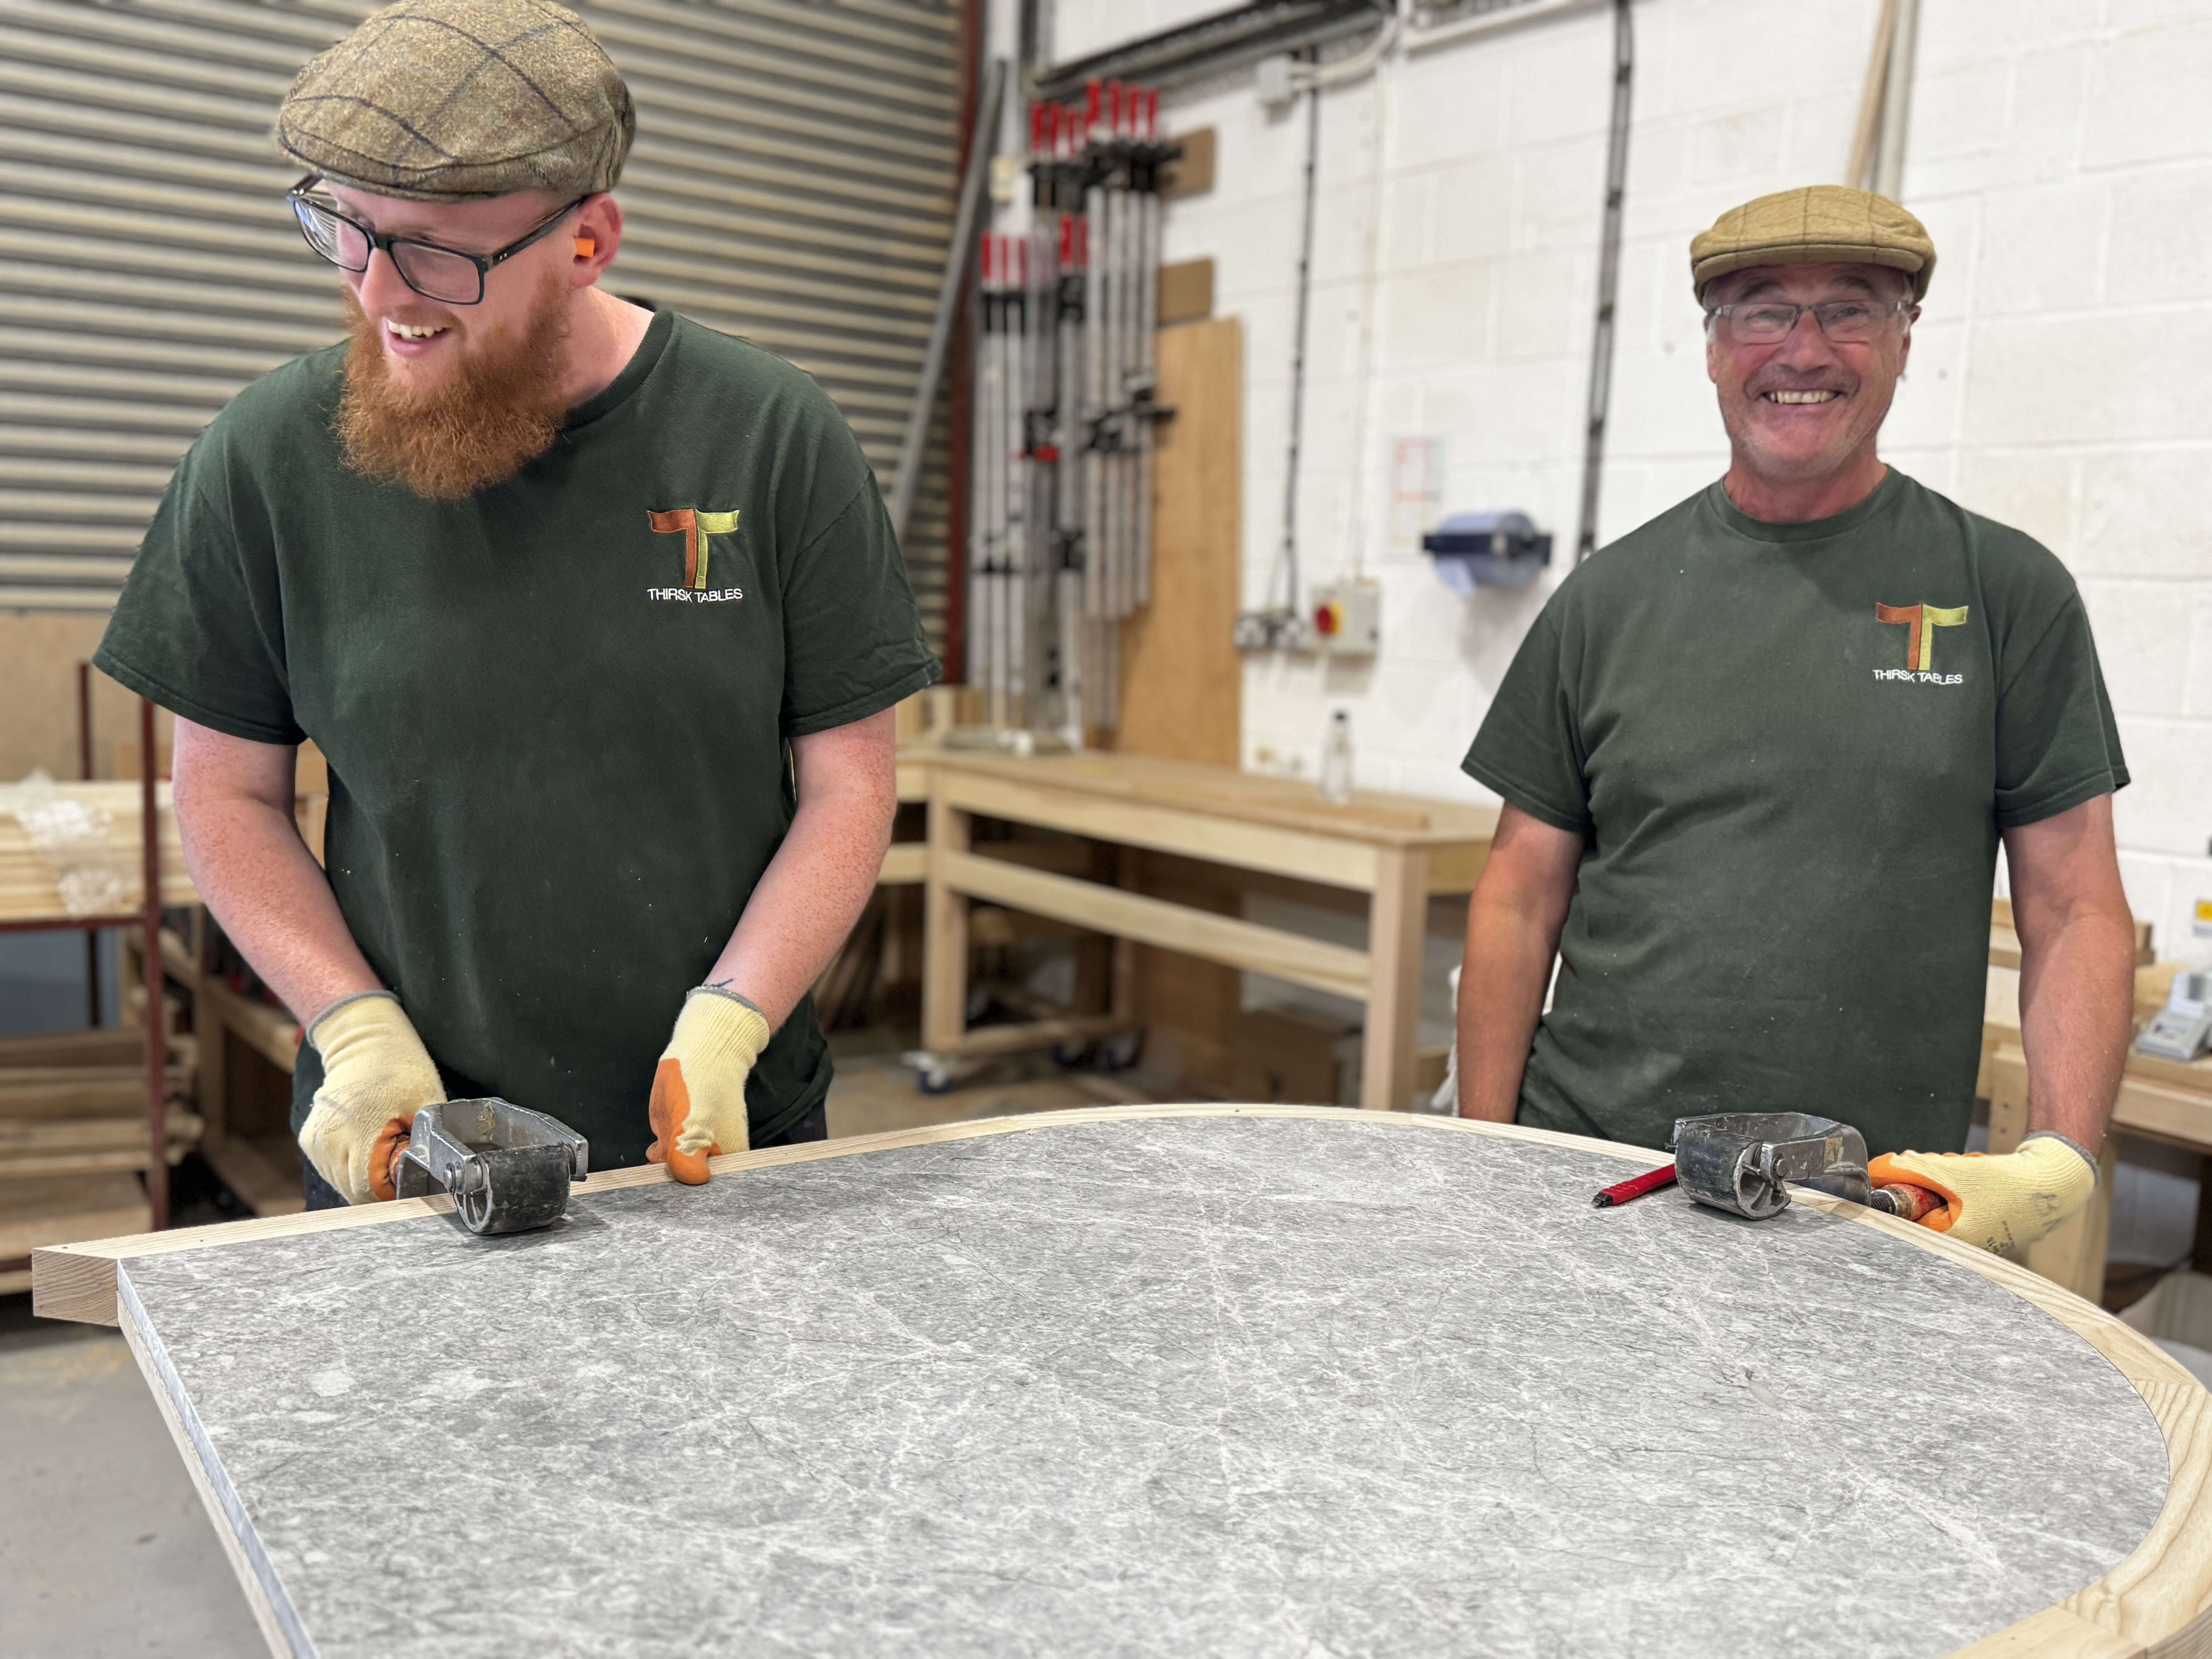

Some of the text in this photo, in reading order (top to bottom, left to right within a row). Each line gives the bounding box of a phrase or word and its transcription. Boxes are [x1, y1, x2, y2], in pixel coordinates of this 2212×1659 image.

[647, 588, 743, 603] THIRSK TABLES
[1873, 670, 1963, 685] THIRSK TABLES
